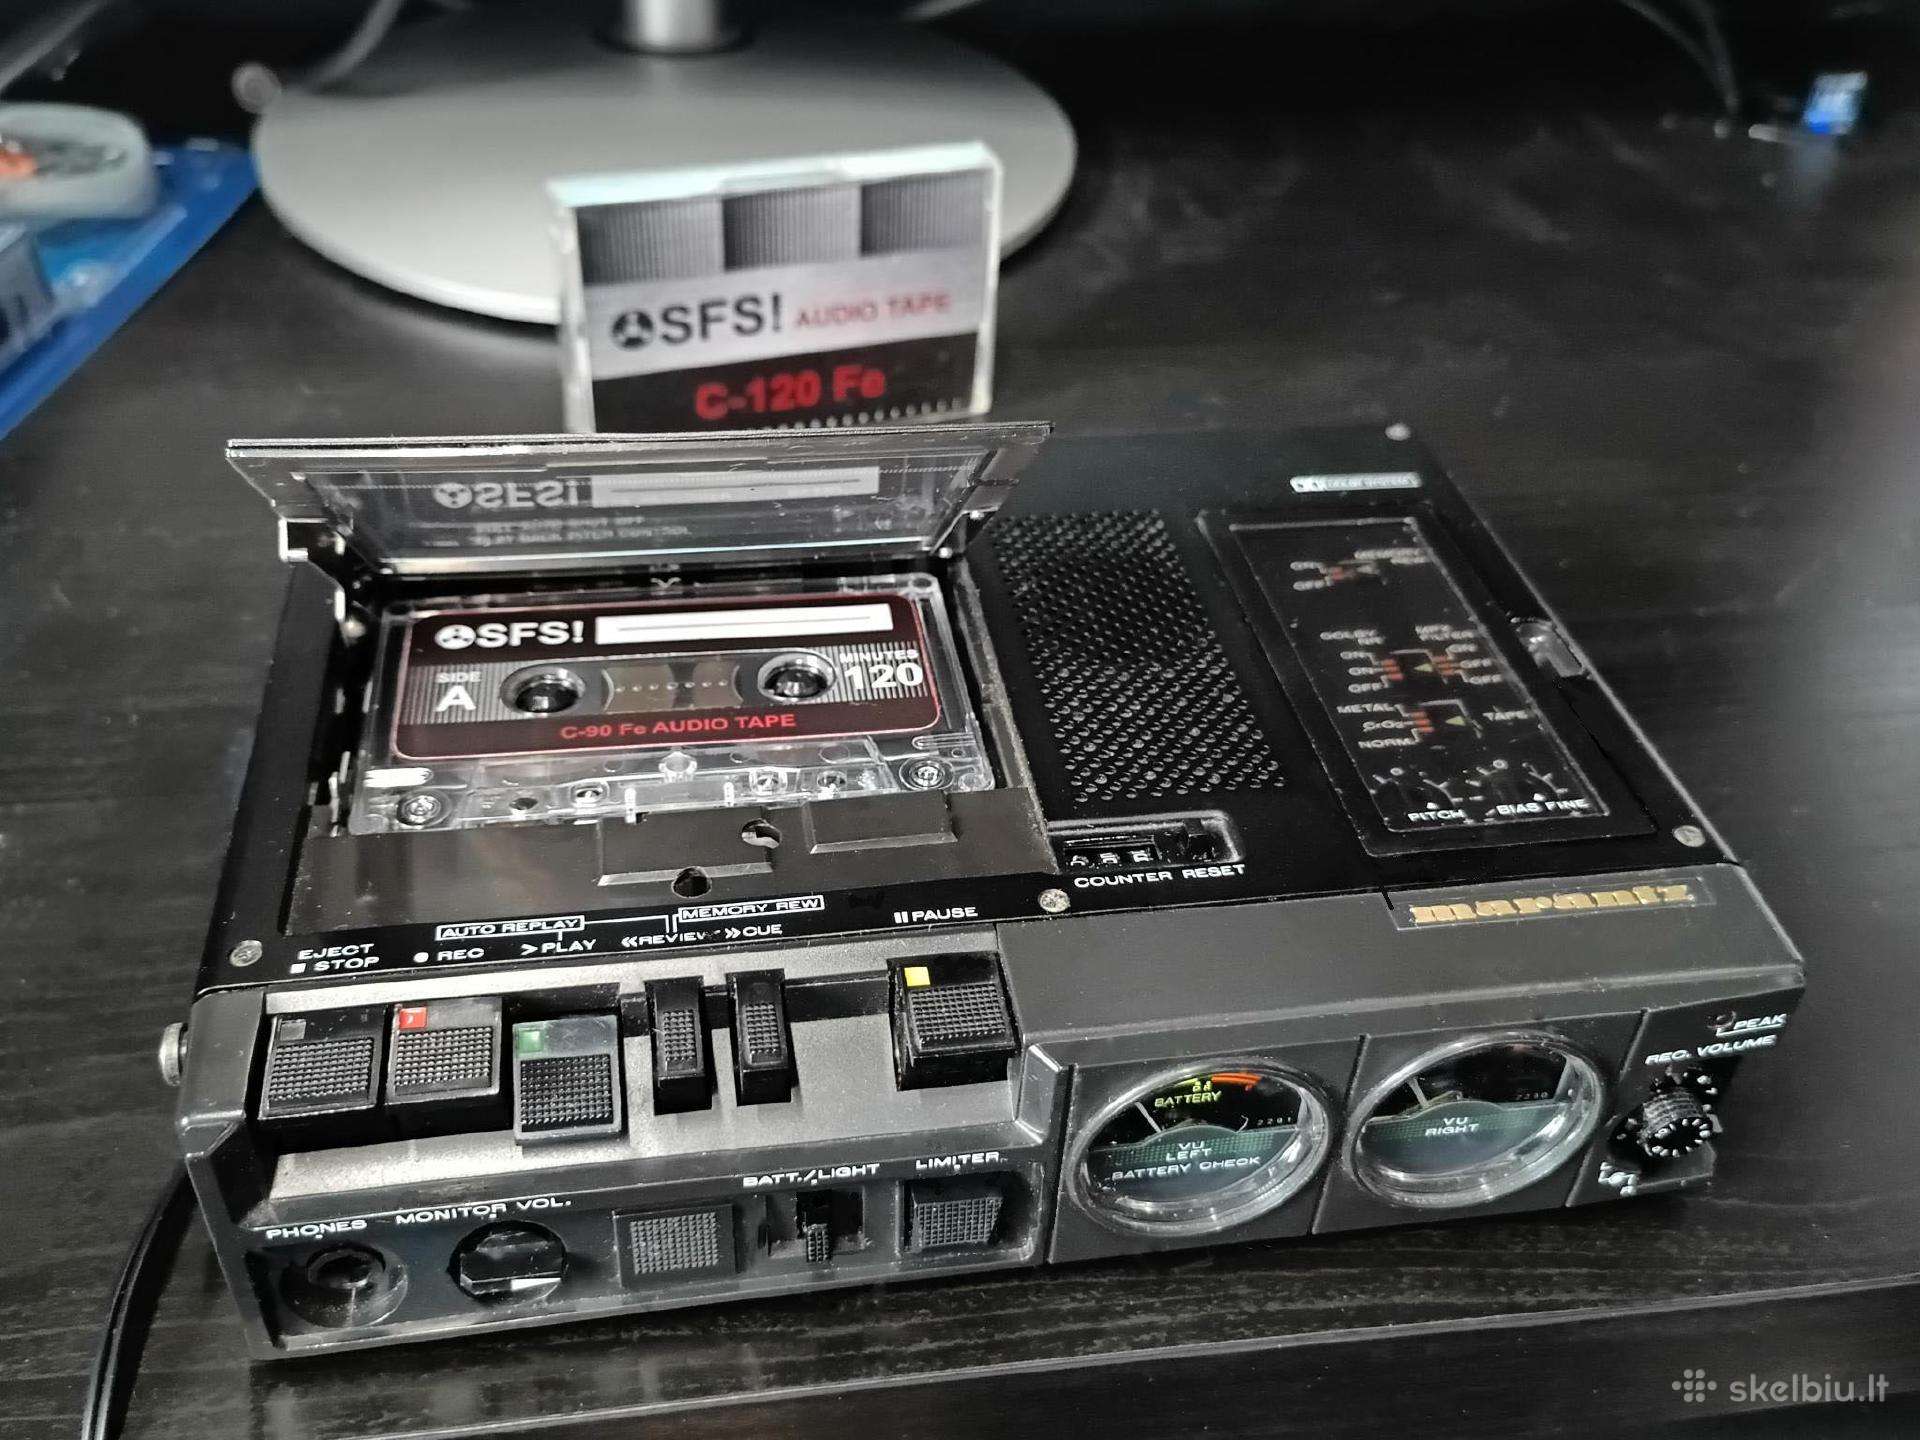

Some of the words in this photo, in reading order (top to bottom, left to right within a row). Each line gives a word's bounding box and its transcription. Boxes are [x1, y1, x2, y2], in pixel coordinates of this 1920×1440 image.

[660, 293, 783, 345] SFS!
[797, 303, 880, 329] AUDIO
[888, 293, 952, 319] TAPE
[694, 370, 822, 420] C-120
[832, 364, 886, 400] Fe
[475, 620, 584, 648] SFS!
[838, 647, 919, 662] MINUTES
[436, 671, 482, 684] SIDE
[843, 662, 924, 690] 120
[436, 685, 477, 713] A
[560, 724, 613, 741] C-90
[618, 722, 648, 738] Fe
[653, 717, 729, 734] AUDIO
[736, 714, 797, 730] TAPE
[1407, 809, 1467, 823] PITCH
[1496, 802, 1542, 816] BIAS
[1545, 799, 1590, 811] FINE
[1074, 871, 1173, 888] COUNTER
[1181, 864, 1245, 879] RESET
[682, 904, 768, 920] MEMORY
[776, 898, 819, 911] REW
[912, 906, 978, 922] PAUSE
[441, 925, 496, 938] AUTO
[502, 918, 579, 934] REPLAY
[743, 924, 783, 937] CUE
[297, 943, 375, 960] EJECT
[437, 948, 485, 962] REC
[541, 939, 597, 954] PLAY
[313, 957, 380, 972] STOP
[1734, 1013, 1787, 1030] PEAK
[1645, 1050, 1692, 1065] REC.
[1697, 1034, 1777, 1057] VOLUME
[1154, 1090, 1222, 1107] BATTERY
[1443, 1116, 1469, 1126] VU
[1425, 1123, 1480, 1137] RIGHT
[1178, 1141, 1205, 1150] VU
[915, 1151, 1000, 1170] LIMITER
[1165, 1148, 1212, 1162] LEFT
[1112, 1163, 1191, 1181] BATTERY
[1200, 1156, 1261, 1170] CHECK
[395, 1202, 507, 1225] MONITOR
[516, 1197, 572, 1210] VOL.
[266, 1219, 367, 1240] PHONES
